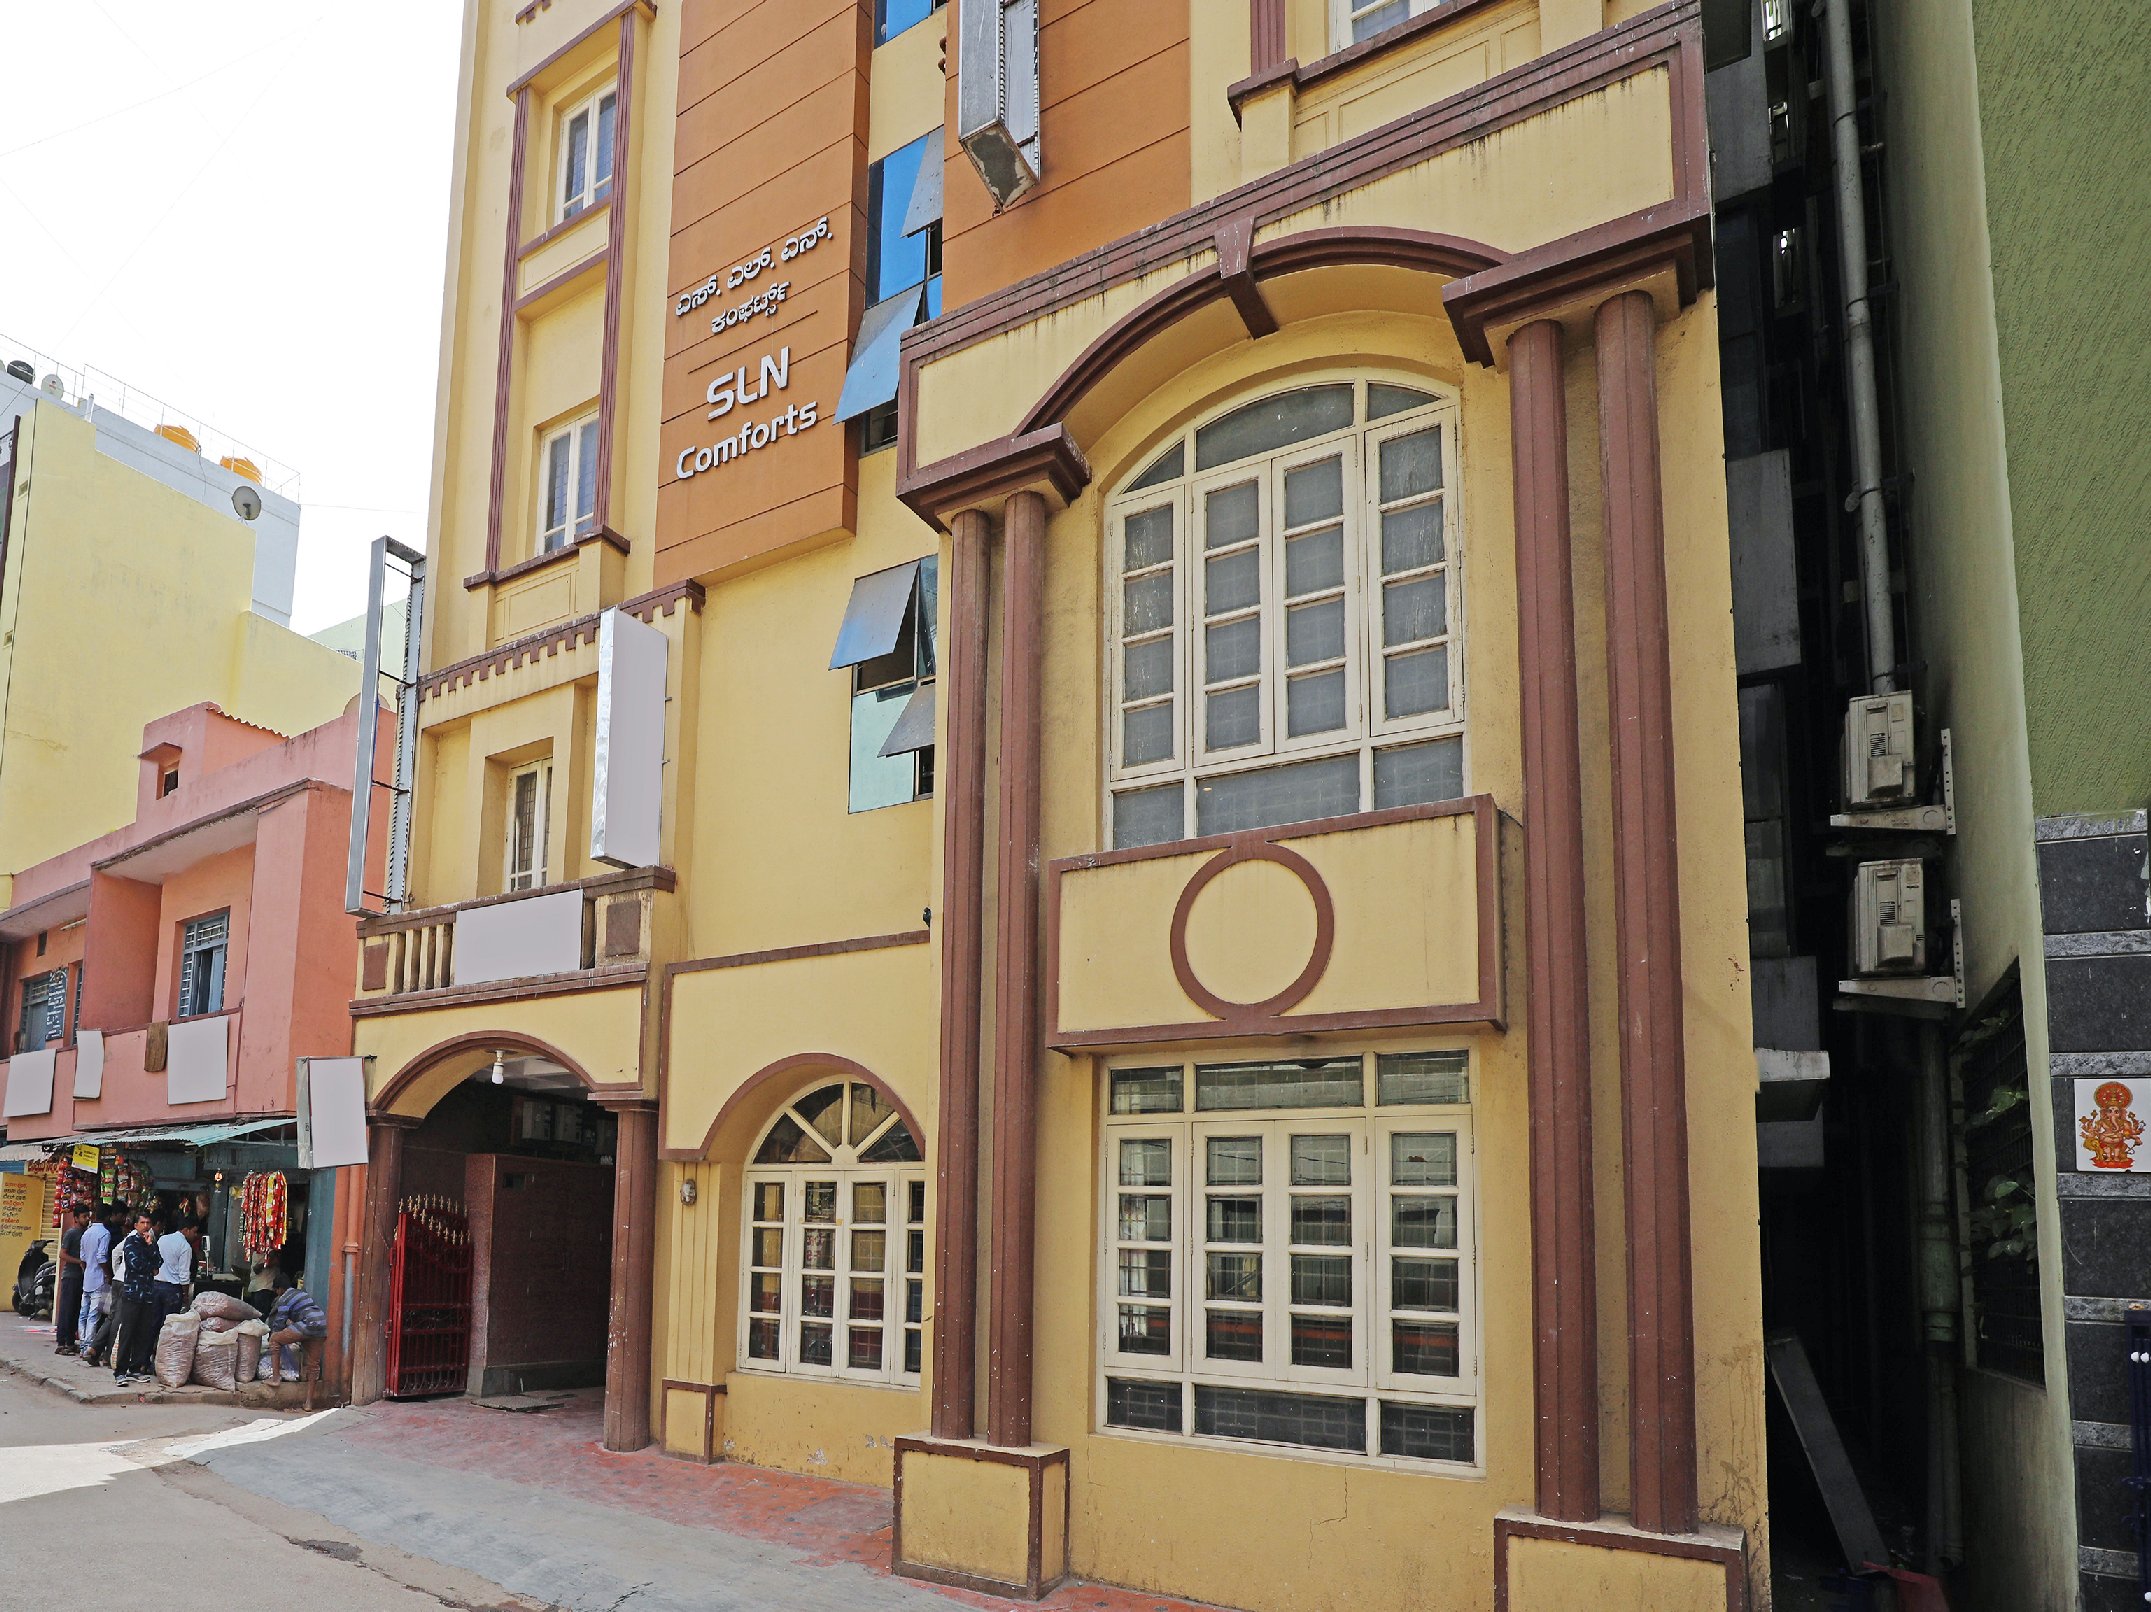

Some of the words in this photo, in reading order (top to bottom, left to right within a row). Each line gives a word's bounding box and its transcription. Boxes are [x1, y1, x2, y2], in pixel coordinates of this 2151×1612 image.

[675, 274, 721, 317] ಎಸ್.
[727, 246, 775, 289] ಎಲ್.
[780, 216, 833, 262] ಎನ್.
[706, 345, 790, 421] SLN
[676, 400, 817, 479] Comforts
